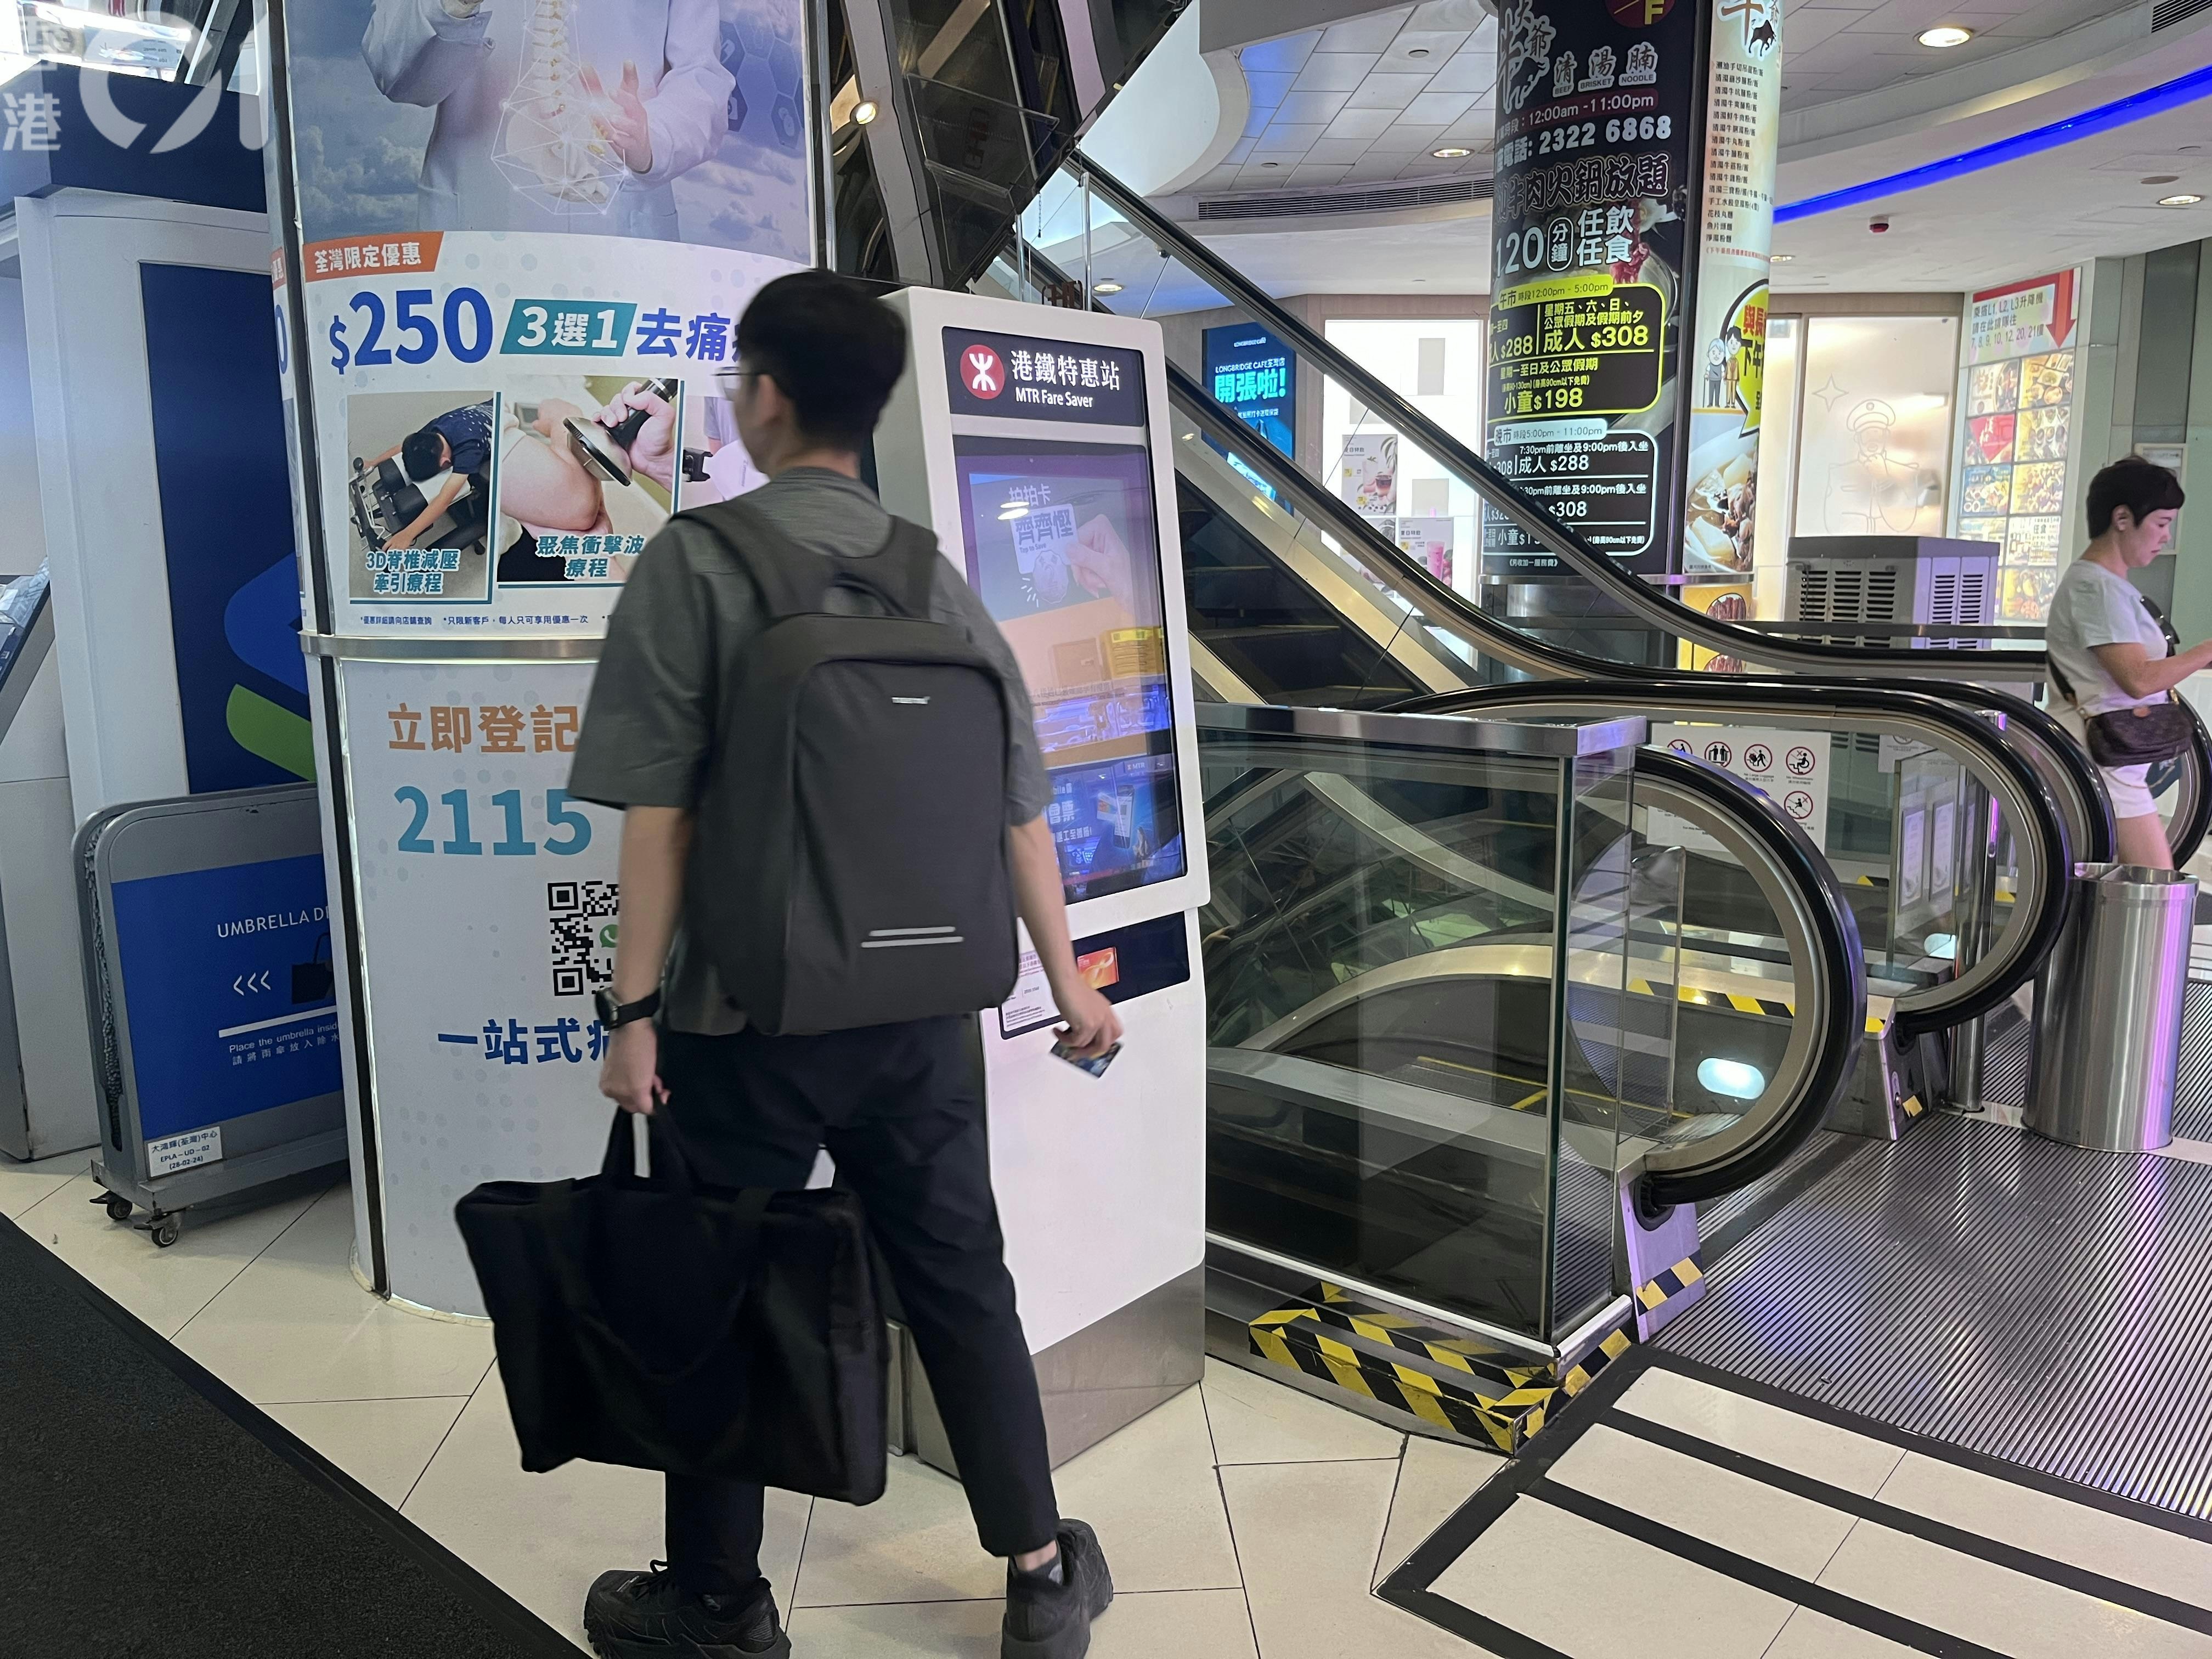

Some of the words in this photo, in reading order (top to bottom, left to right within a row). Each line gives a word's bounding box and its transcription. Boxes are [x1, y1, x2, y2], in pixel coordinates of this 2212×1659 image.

[1555, 85, 1572, 95] BEEF
[1580, 78, 1612, 89] BRISKET
[1621, 74, 1654, 83] NOODLE
[1530, 105, 1578, 125] 12:00am
[1539, 122, 1596, 155] 2322
[1605, 115, 1671, 143] 6868
[1577, 205, 1634, 238] 任飲
[1496, 227, 1544, 277] 120
[1551, 223, 1568, 263] 分鐘
[1576, 234, 1633, 267] 任食
[314, 241, 422, 274] 荃灣限定優惠
[1574, 283, 1609, 293] 5:00pm
[329, 287, 493, 375] $250
[517, 306, 618, 349] 3選1
[636, 308, 740, 362] 去痛
[1544, 310, 1644, 330] 公眾假期及假期前夕
[1500, 335, 1533, 359] $288
[1543, 328, 1585, 353] 成人
[1590, 325, 1649, 348] $308
[1010, 349, 1120, 391] 港鐵特惠站
[1215, 362, 1253, 374] LONGBRIDGE
[1015, 386, 1040, 402] MTR
[1041, 390, 1064, 405] Fare
[1065, 393, 1093, 408] Saver
[1215, 368, 1286, 403] 開張啦!
[1565, 427, 1602, 436] 11:00pm
[1518, 456, 1547, 474] 成人
[1550, 454, 1589, 472] $288
[537, 534, 645, 558] 聚焦衝擊波
[365, 550, 460, 572] 3D脊椎減壓
[565, 557, 608, 580] 療程
[374, 573, 444, 594] 牽引療程
[387, 702, 579, 754] 立即登記
[393, 785, 592, 856] 2115
[217, 910, 309, 938] UMBRELLA
[229, 1041, 255, 1053] Place
[258, 1037, 273, 1046] the
[276, 1028, 314, 1043] umbrella
